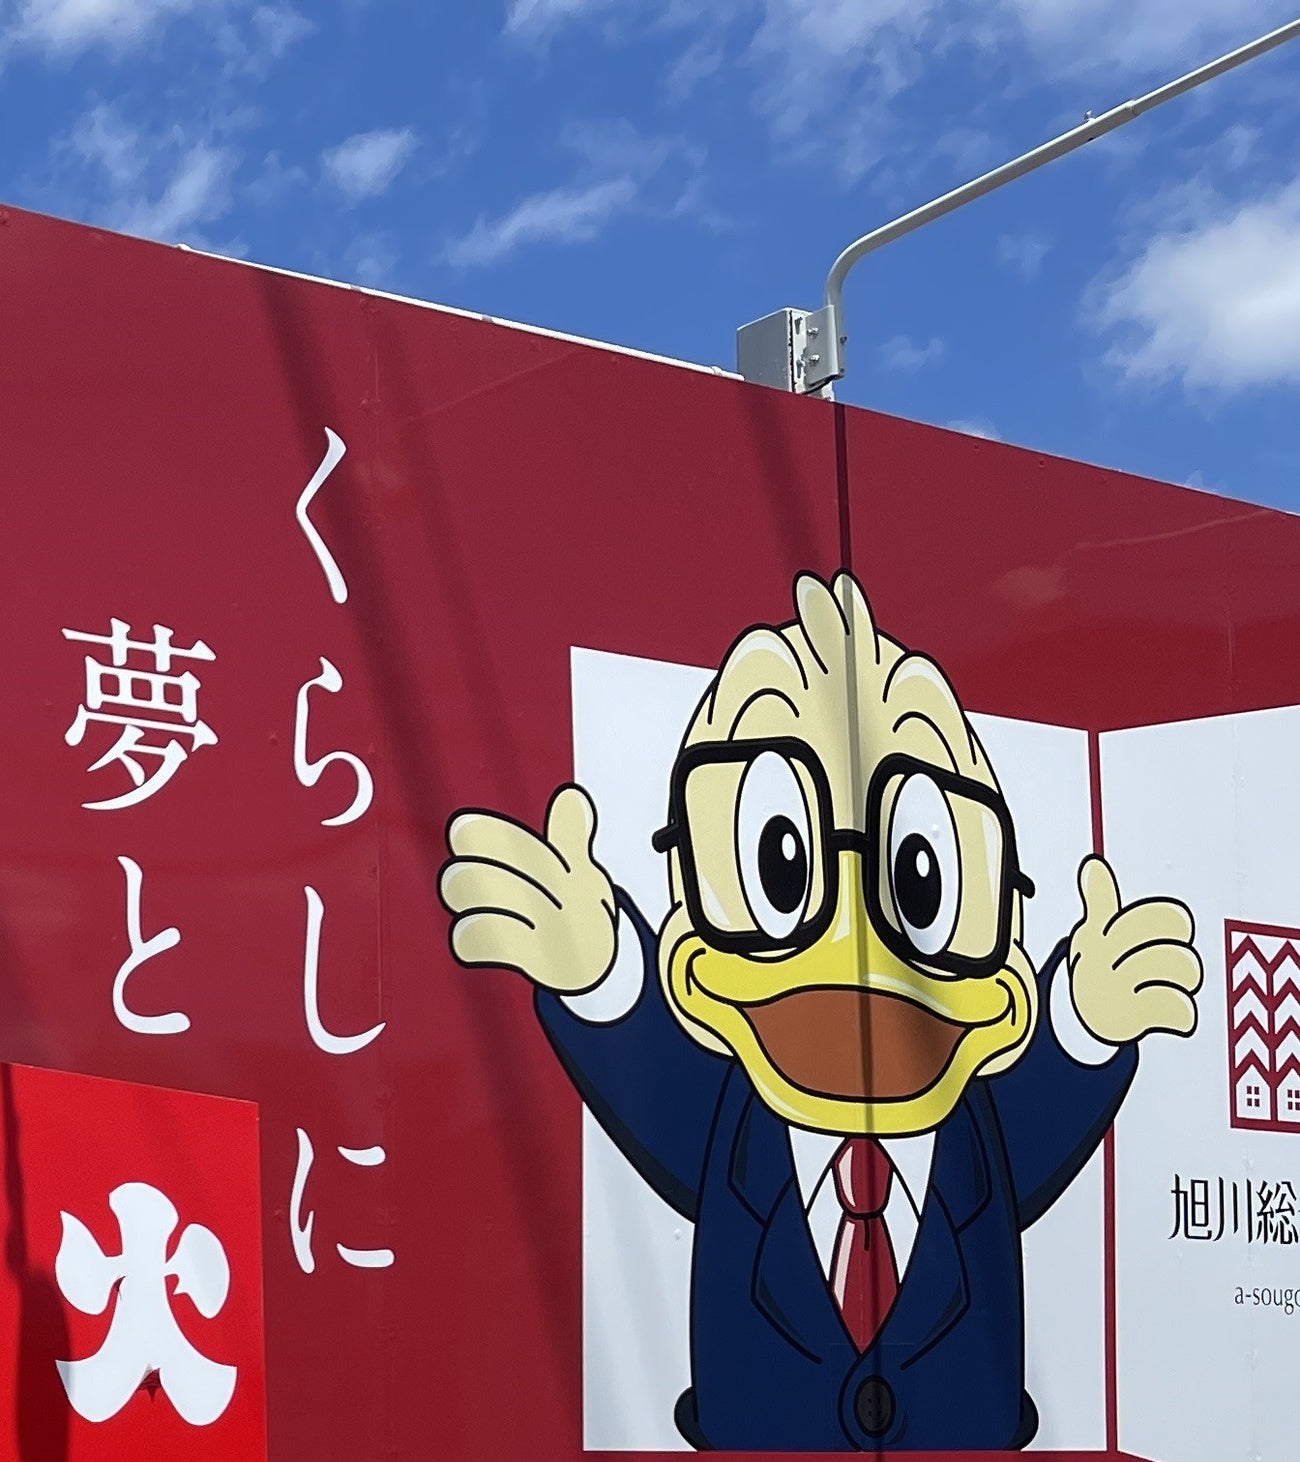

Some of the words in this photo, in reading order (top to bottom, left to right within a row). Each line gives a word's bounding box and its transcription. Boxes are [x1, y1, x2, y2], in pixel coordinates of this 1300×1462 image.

[61, 617, 218, 1034] 夢と
[289, 427, 395, 1274] くらしに
[1168, 1173, 1300, 1245] 旭川総
